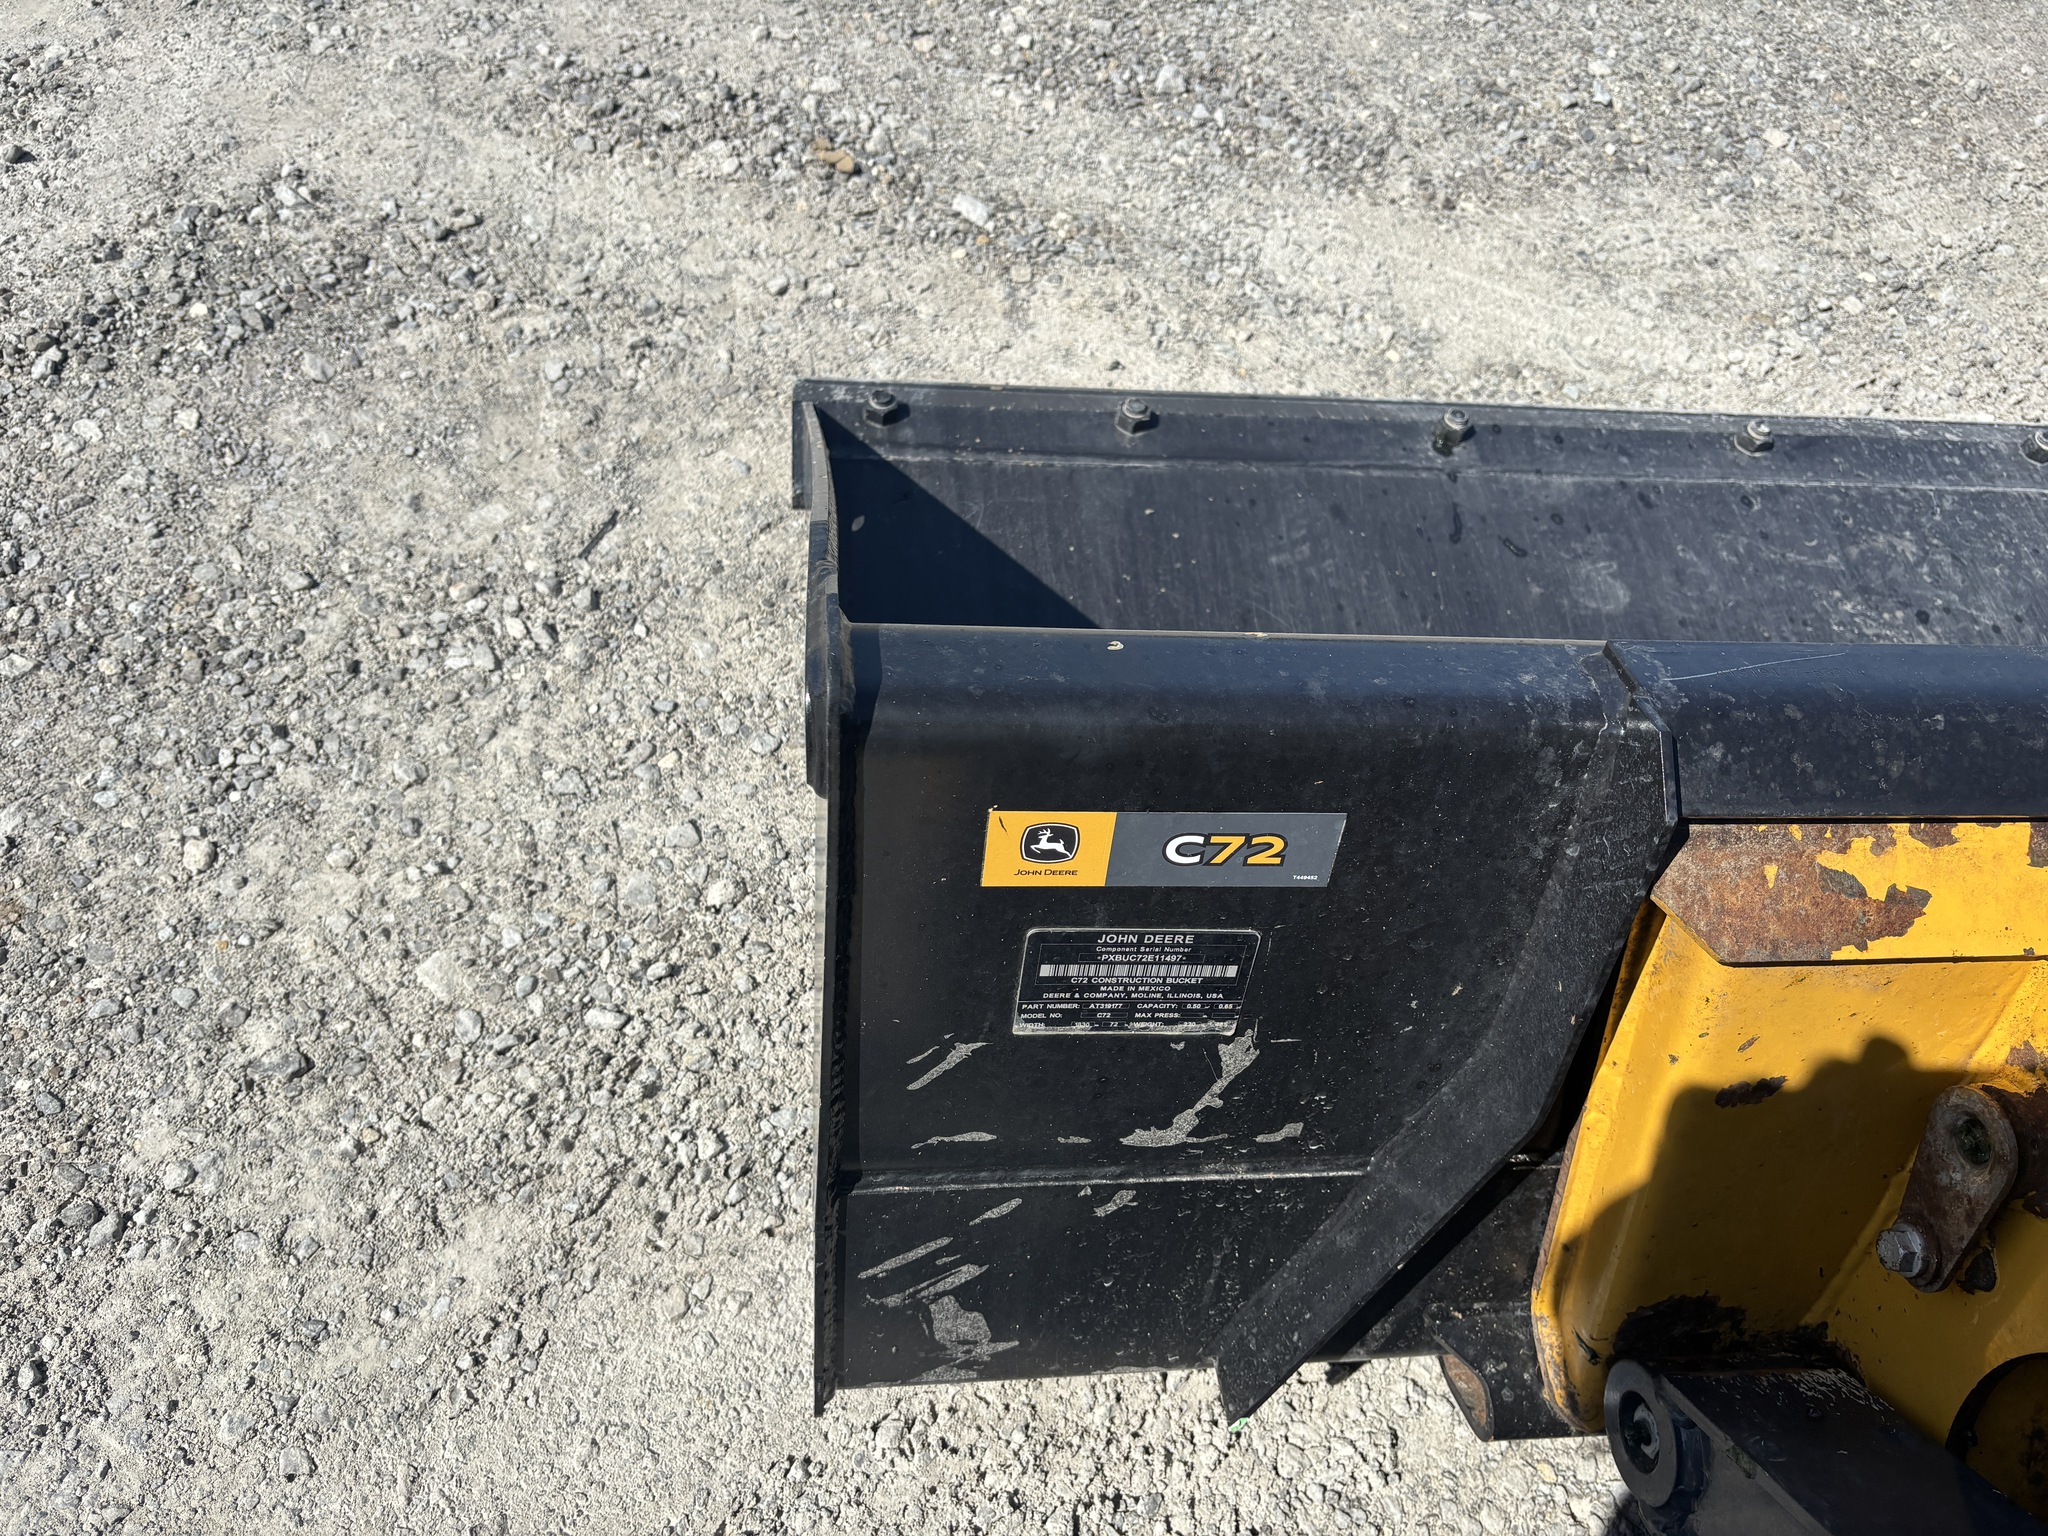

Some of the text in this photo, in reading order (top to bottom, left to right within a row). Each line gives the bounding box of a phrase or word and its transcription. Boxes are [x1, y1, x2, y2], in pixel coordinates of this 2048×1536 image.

[1162, 832, 1288, 866] C72
[1097, 934, 1195, 944] JOHN DEERE
